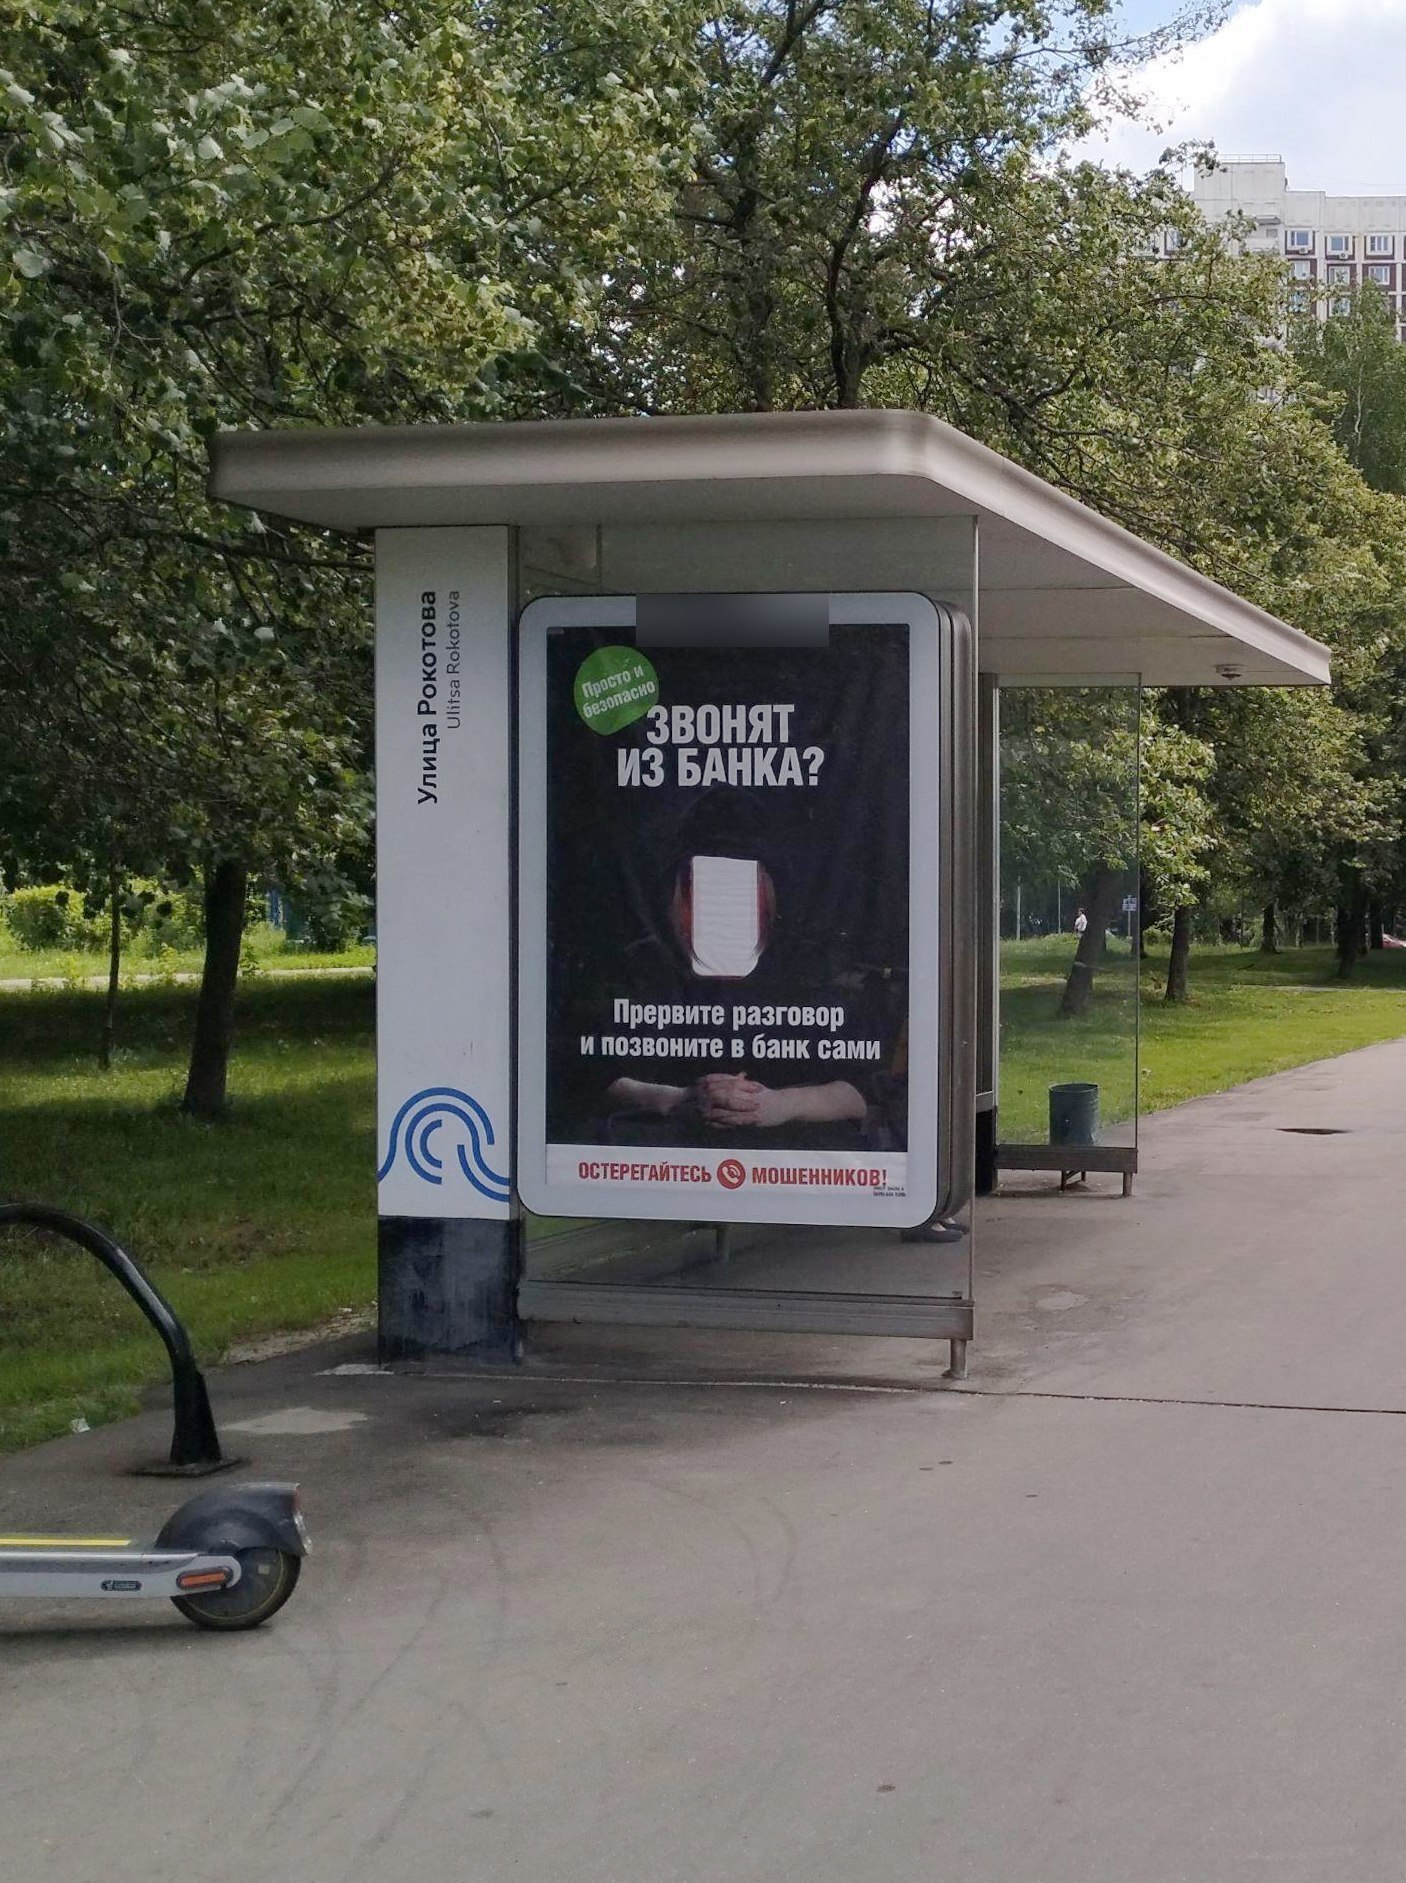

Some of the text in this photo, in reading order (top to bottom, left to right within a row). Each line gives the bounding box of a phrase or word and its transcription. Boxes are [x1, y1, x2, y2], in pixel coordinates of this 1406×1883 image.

[446, 591, 461, 729] Ulitsa Rokotova
[417, 591, 441, 805] Улица Рокотова
[582, 664, 645, 699] Просто и
[582, 680, 656, 719] безопасно
[646, 704, 795, 745] ЗВОНЯТ
[617, 746, 825, 788] ИЗ БАНКА?
[613, 998, 845, 1032] Прервите разговор
[580, 1033, 881, 1060] и позвоните в банк сами
[578, 1161, 887, 1187] ОСТЕРЕГАЙТЕСЬ МОШЕННИКОВ!
